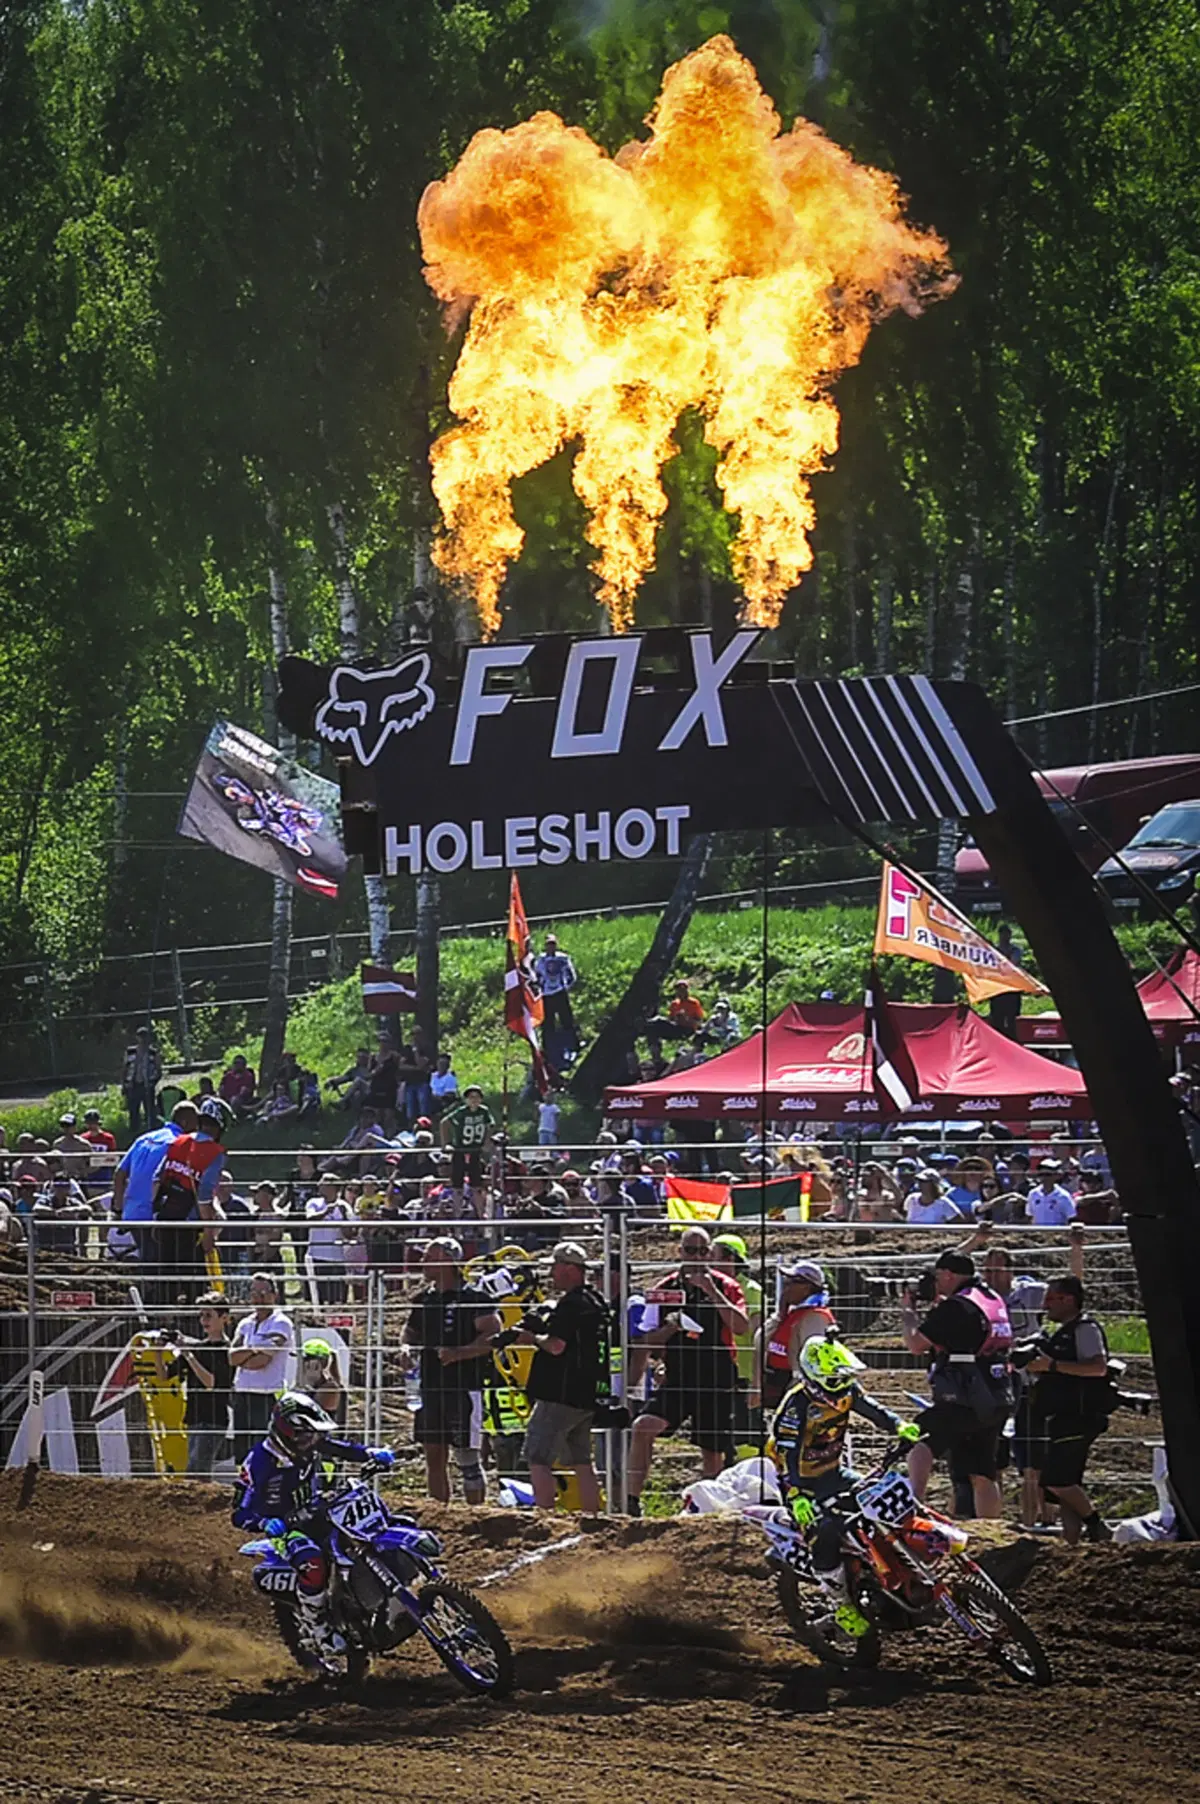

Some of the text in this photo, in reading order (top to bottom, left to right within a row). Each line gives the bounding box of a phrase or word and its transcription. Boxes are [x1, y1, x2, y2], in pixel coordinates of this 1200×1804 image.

[450, 629, 766, 765] FOX
[384, 804, 691, 878] HOLESHOT
[462, 1123, 486, 1145] 99
[340, 1488, 382, 1527] 461
[870, 1480, 914, 1522] 222
[260, 1572, 297, 1592] 461
